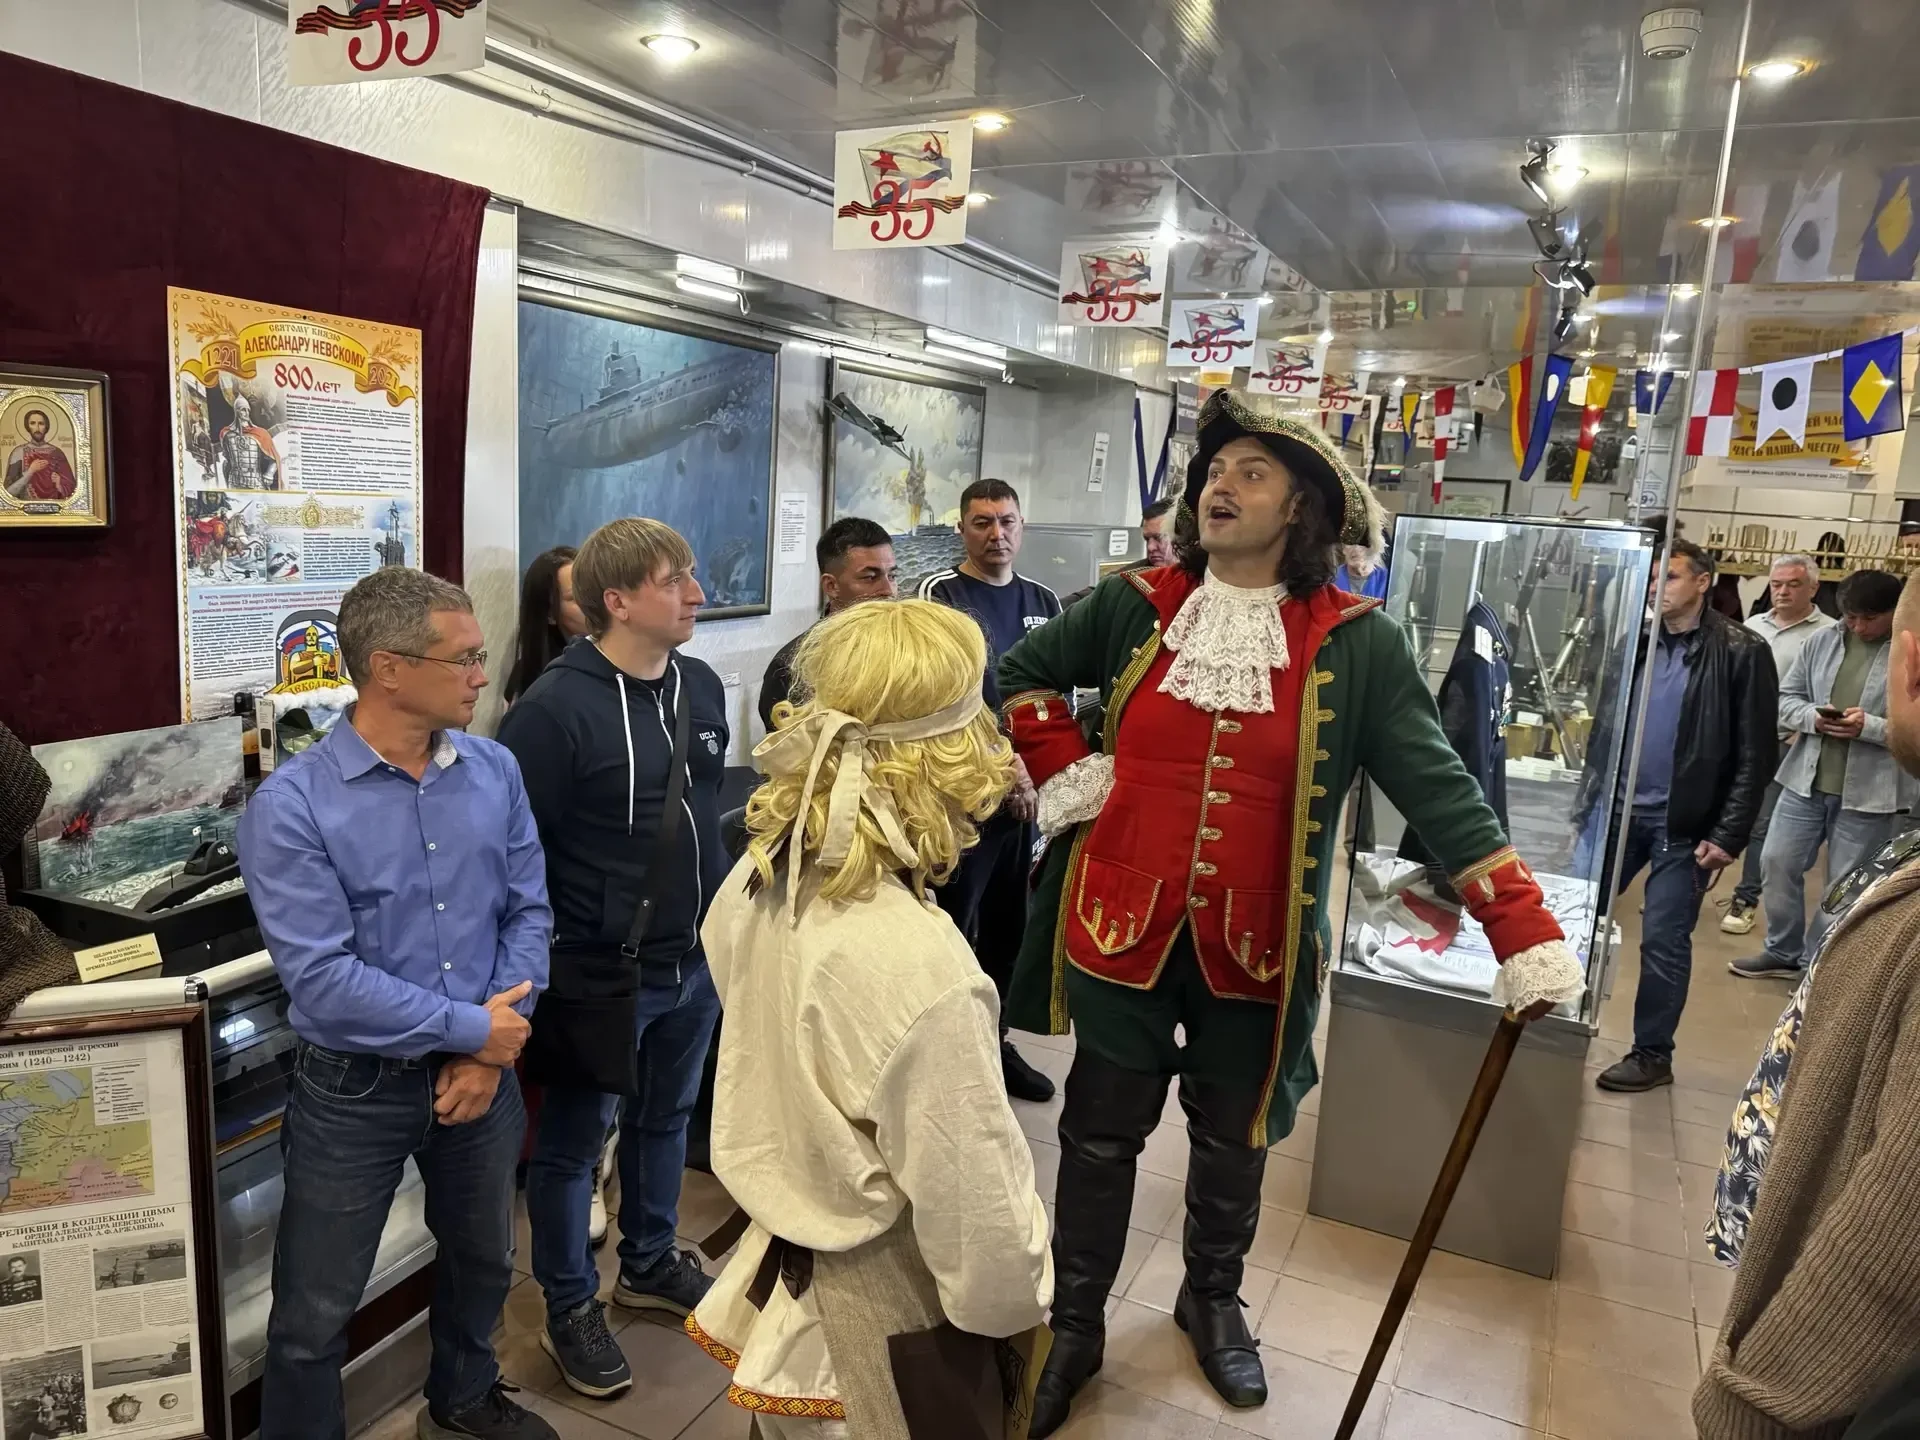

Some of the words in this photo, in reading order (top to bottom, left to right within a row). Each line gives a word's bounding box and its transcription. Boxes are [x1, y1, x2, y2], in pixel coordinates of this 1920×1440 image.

[348, 0, 440, 71] 35
[871, 179, 935, 241] 35
[1086, 278, 1136, 322] 35
[268, 323, 310, 336] СВЯТОМУ
[312, 328, 341, 342] КНЯЗЮ
[206, 346, 239, 371] 1221
[245, 334, 311, 354] АЛЕКСАНДРУ
[312, 338, 366, 368] НЕВСКОМУ
[1191, 329, 1232, 363] 35
[274, 362, 314, 392] 800
[369, 366, 398, 391] 2021
[1267, 365, 1304, 393] 35
[1318, 386, 1350, 411] 35
[1733, 444, 1763, 457] ЧАСТЬ
[1807, 441, 1841, 454] ЧЕСТИ
[699, 730, 717, 740] UCLA
[28, 1045, 74, 1056] шведской
[78, 1041, 119, 1052] агрессии
[0, 1223, 58, 1238] РЕЛИКВИЯ
[62, 1221, 69, 1229] В
[72, 1210, 139, 1228] КОЛЛЕКЦИИ
[142, 1206, 176, 1218] ЦВММ
[24, 1231, 53, 1241] ОРДЕН
[55, 1222, 110, 1236] АЛЕКСАНДРА
[112, 1216, 155, 1228] НЕВСКОГО
[12, 1238, 59, 1249] КАПИТАНА
[67, 1231, 93, 1241] РАНГА
